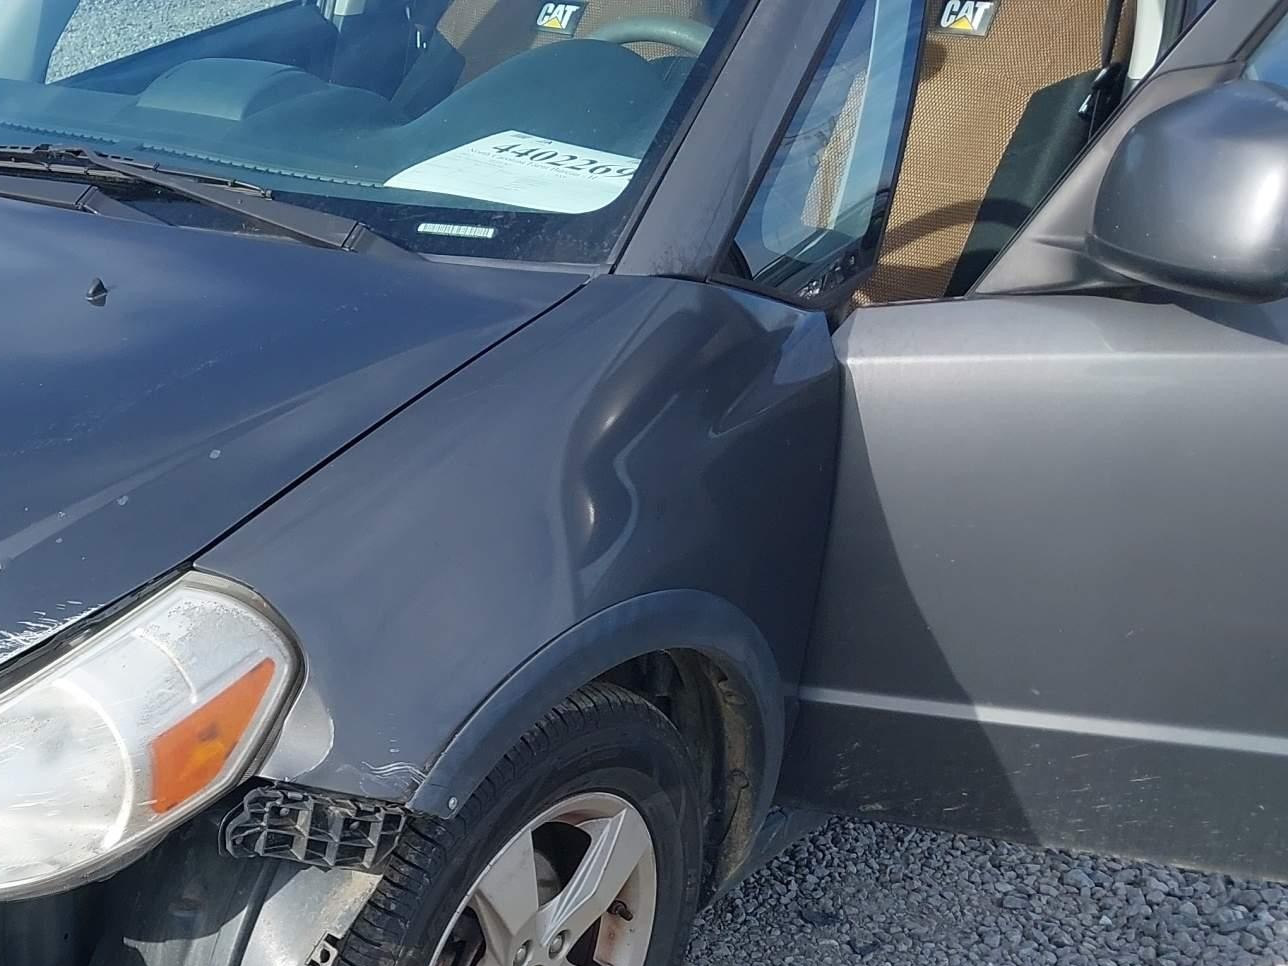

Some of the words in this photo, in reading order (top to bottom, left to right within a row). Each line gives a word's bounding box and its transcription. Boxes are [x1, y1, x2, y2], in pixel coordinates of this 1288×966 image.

[536, 3, 580, 29] CAT
[940, 0, 993, 31] CAT
[492, 143, 634, 178] 4402269
